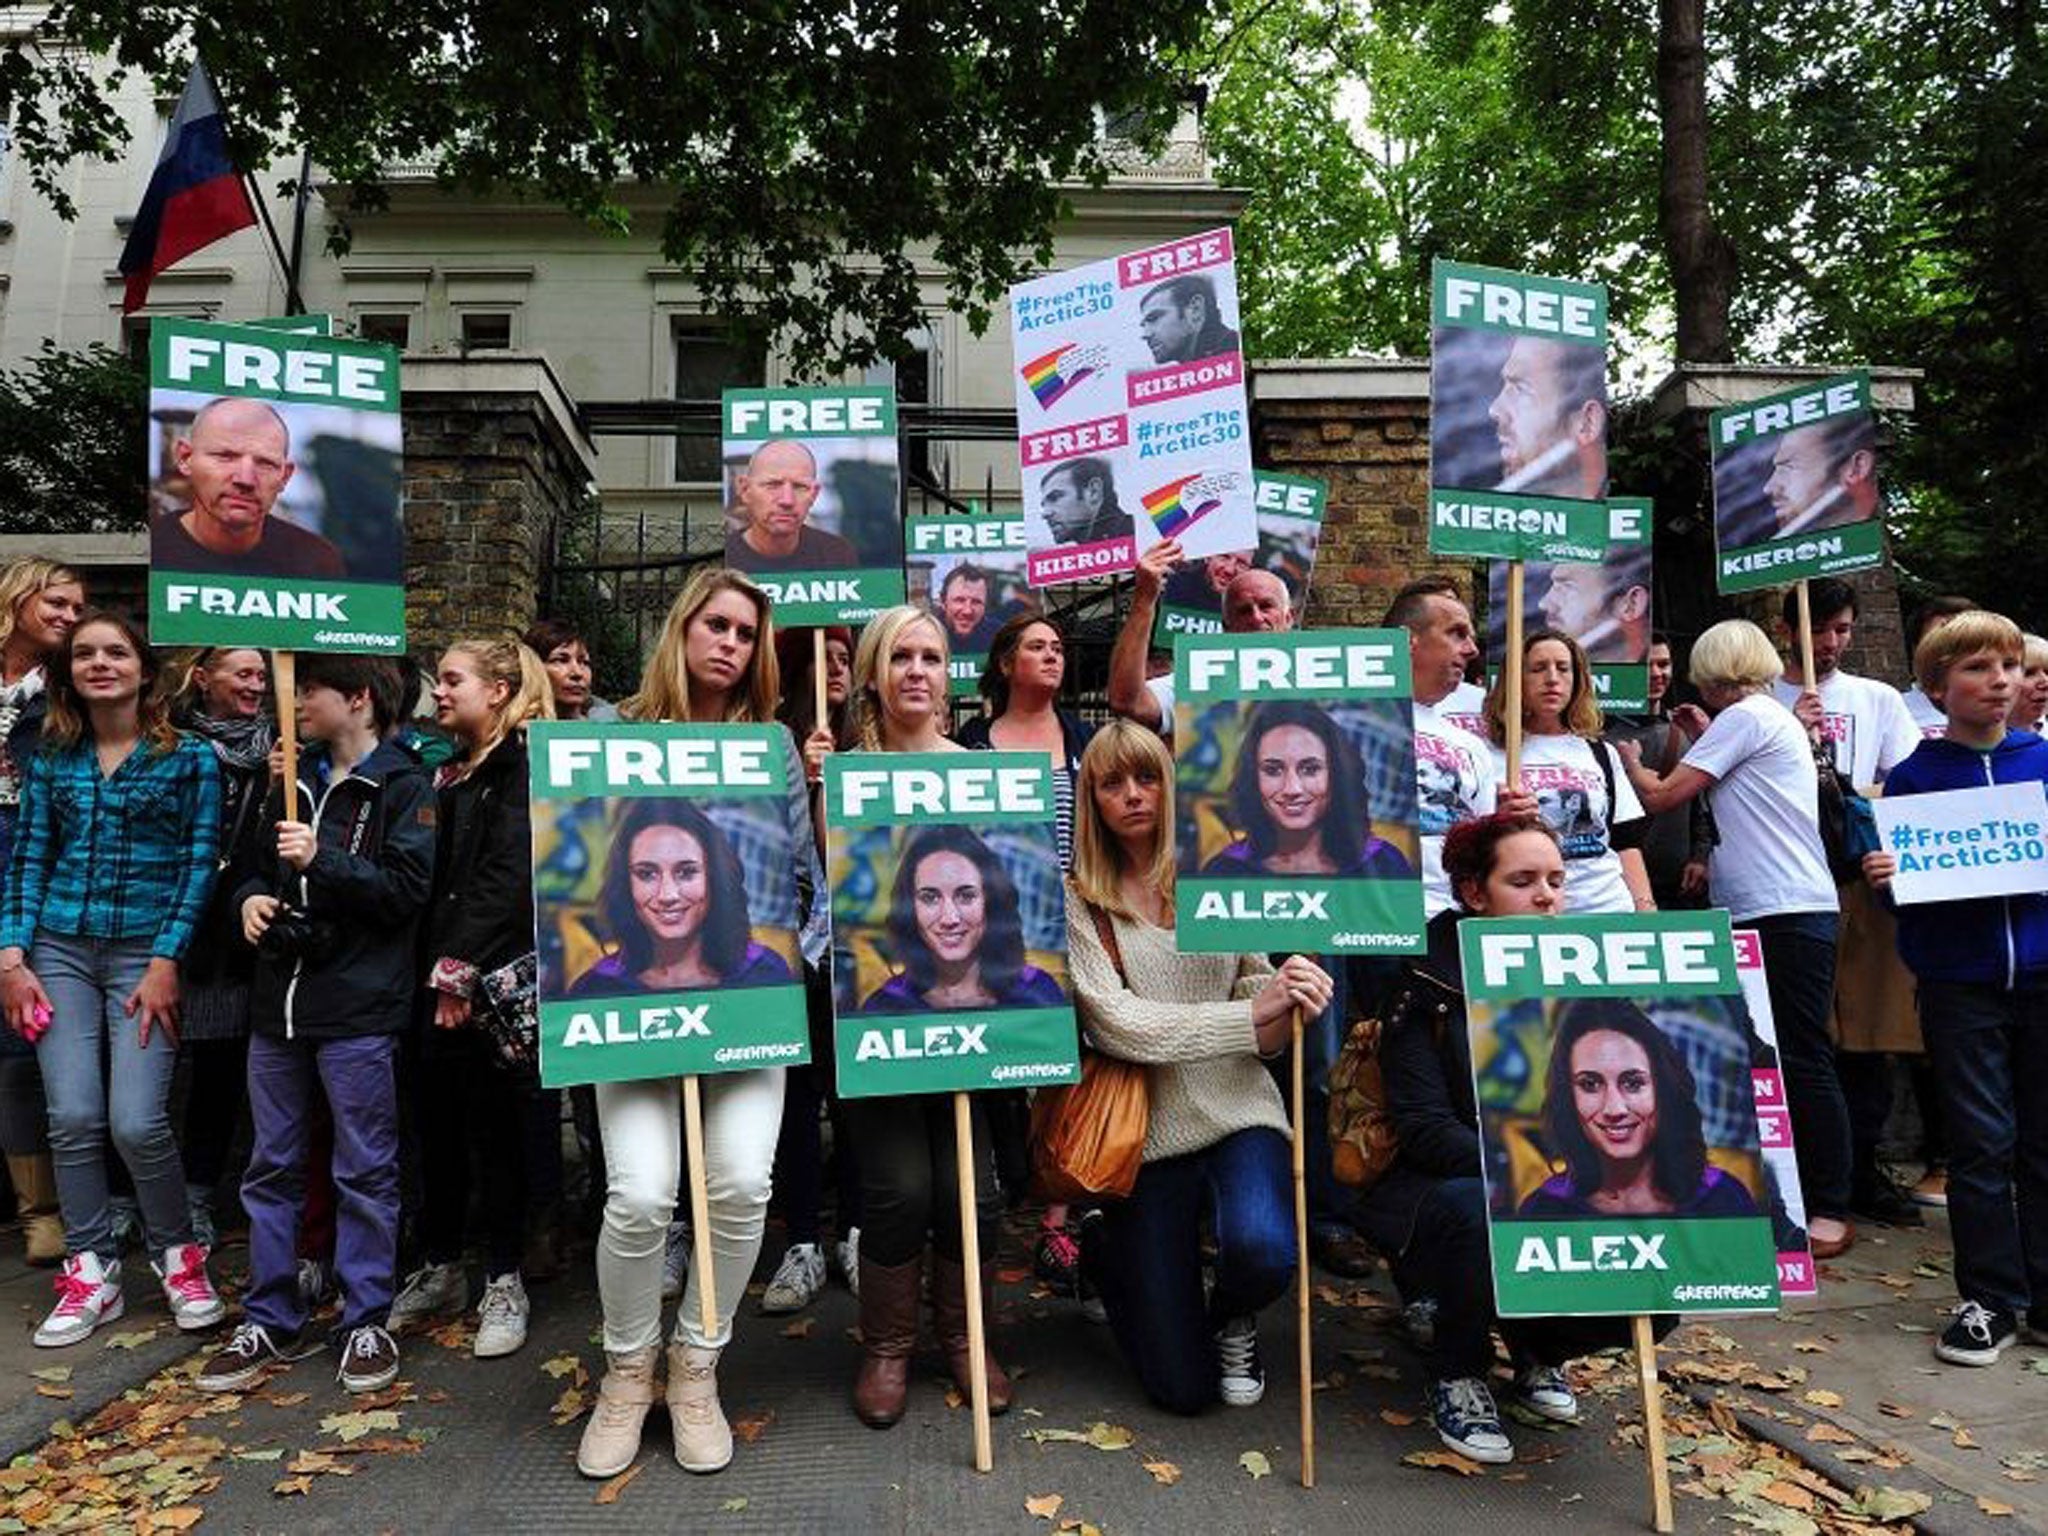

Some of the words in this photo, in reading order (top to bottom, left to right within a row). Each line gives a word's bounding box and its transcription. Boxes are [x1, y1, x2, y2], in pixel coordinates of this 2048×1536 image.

[1127, 238, 1222, 281] FREE
[1016, 280, 1113, 316] #FreeThe
[1018, 294, 1113, 332] Arctic30
[1445, 278, 1597, 338] FREE
[168, 334, 386, 401] FREE
[1134, 362, 1234, 398] KIERON
[731, 397, 884, 434] FREE
[1135, 408, 1240, 441] #FreeThe
[1721, 380, 1861, 444] FREE
[1028, 422, 1119, 461] FREE
[1138, 423, 1241, 459] Arctic30
[914, 520, 1024, 550] FREE
[1435, 501, 1567, 536] KIERON
[1034, 545, 1131, 577] KIERON
[1722, 536, 1843, 575] KIERON
[166, 584, 348, 622] FRANK
[759, 580, 861, 604] RANK
[313, 629, 400, 647] GREENPEACE
[1189, 645, 1396, 691] FREE
[547, 738, 771, 787] FREE
[841, 768, 1045, 817] FREE
[1890, 820, 2040, 849] #FreeThe
[1898, 839, 2044, 873] Arctic30
[1194, 890, 1329, 920] ALEX
[1332, 932, 1420, 948] GREENPEACE
[1480, 930, 1719, 987] FREE
[561, 1004, 713, 1047] ALEX
[856, 1024, 988, 1062] ALEX
[713, 1042, 804, 1063] GREENPEACE
[991, 1062, 1074, 1081] GREENPEACE
[1515, 1234, 1669, 1272] ALEX
[1672, 1284, 1773, 1301] GREENPEACE
